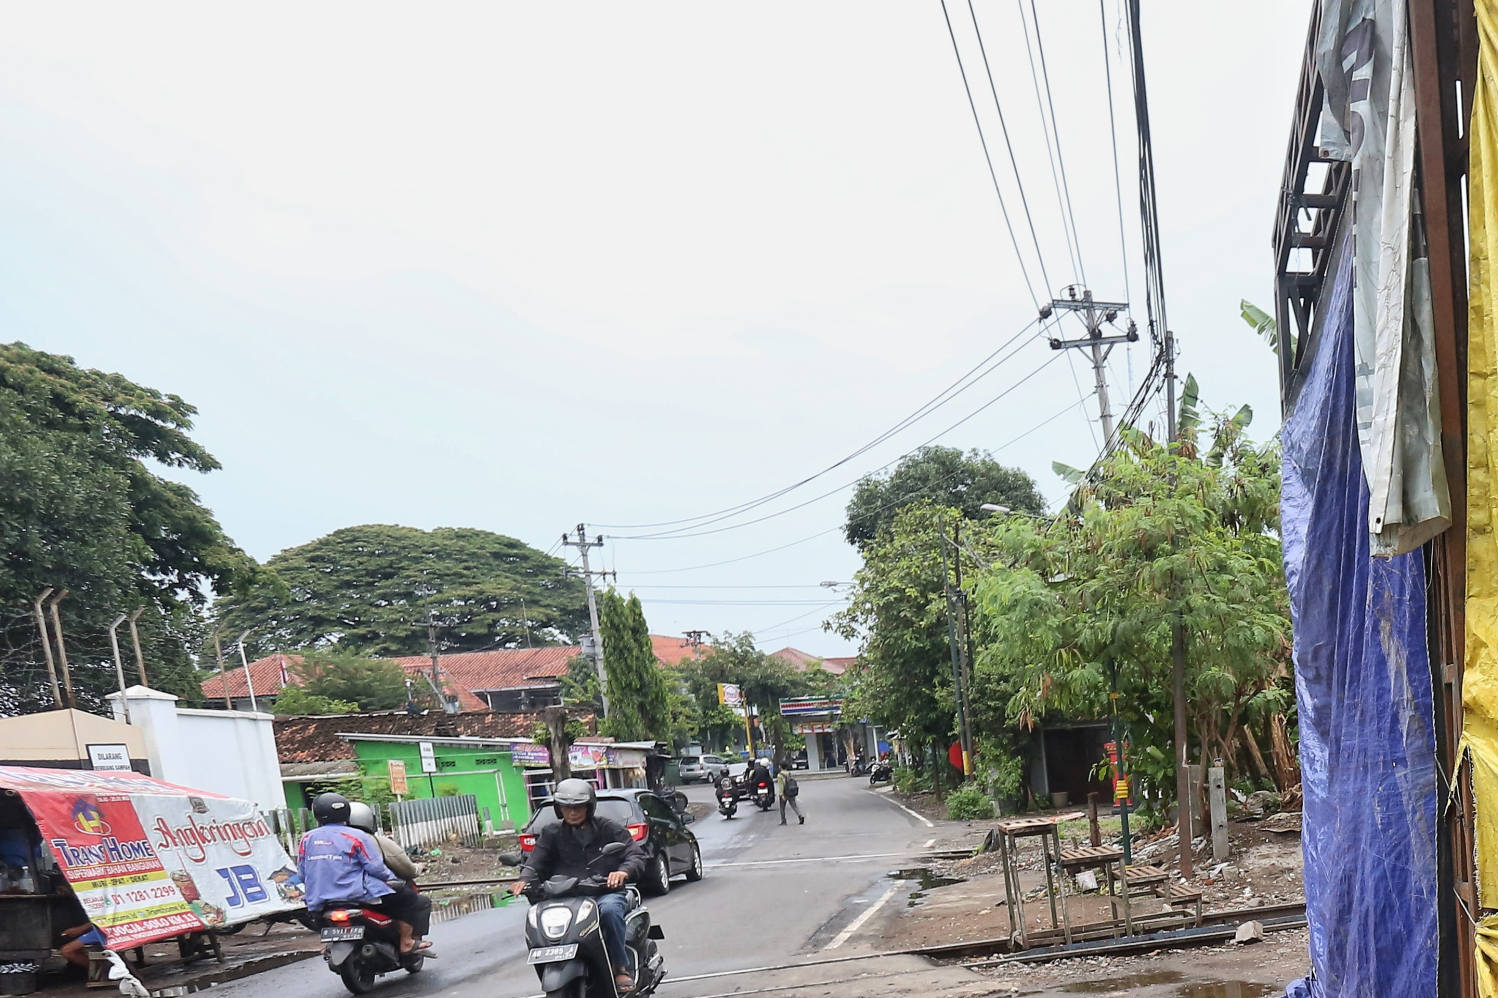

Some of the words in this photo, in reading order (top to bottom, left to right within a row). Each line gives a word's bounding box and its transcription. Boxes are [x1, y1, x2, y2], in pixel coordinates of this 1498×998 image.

[102, 836, 154, 862] HOME
[154, 815, 271, 863] Angkringan
[152, 884, 176, 899] 2299
[216, 864, 269, 908] JB
